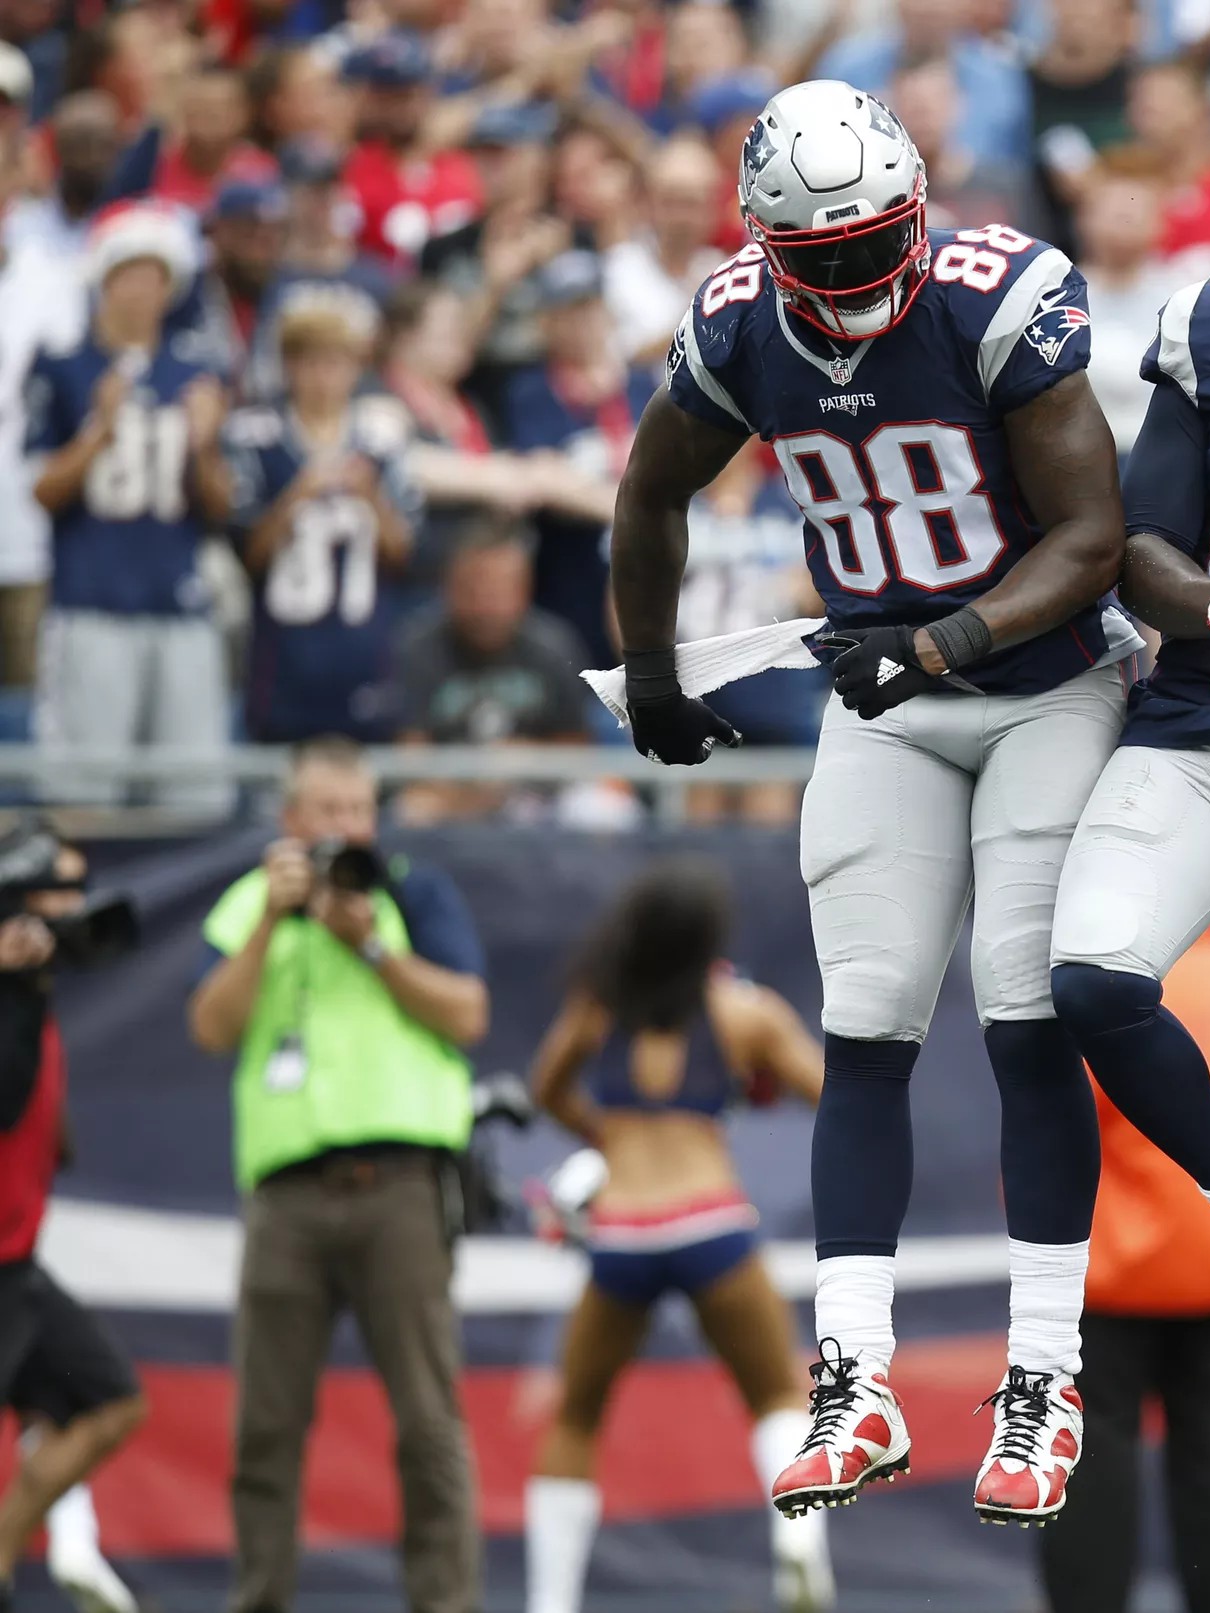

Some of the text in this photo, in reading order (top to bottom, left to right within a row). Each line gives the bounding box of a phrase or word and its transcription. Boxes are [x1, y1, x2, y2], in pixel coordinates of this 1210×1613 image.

[825, 204, 860, 223] PATRIOTS
[832, 369, 849, 381] NFL
[818, 393, 876, 413] PATRIOTS
[772, 419, 1008, 596] 88
[877, 664, 905, 686] adidas
